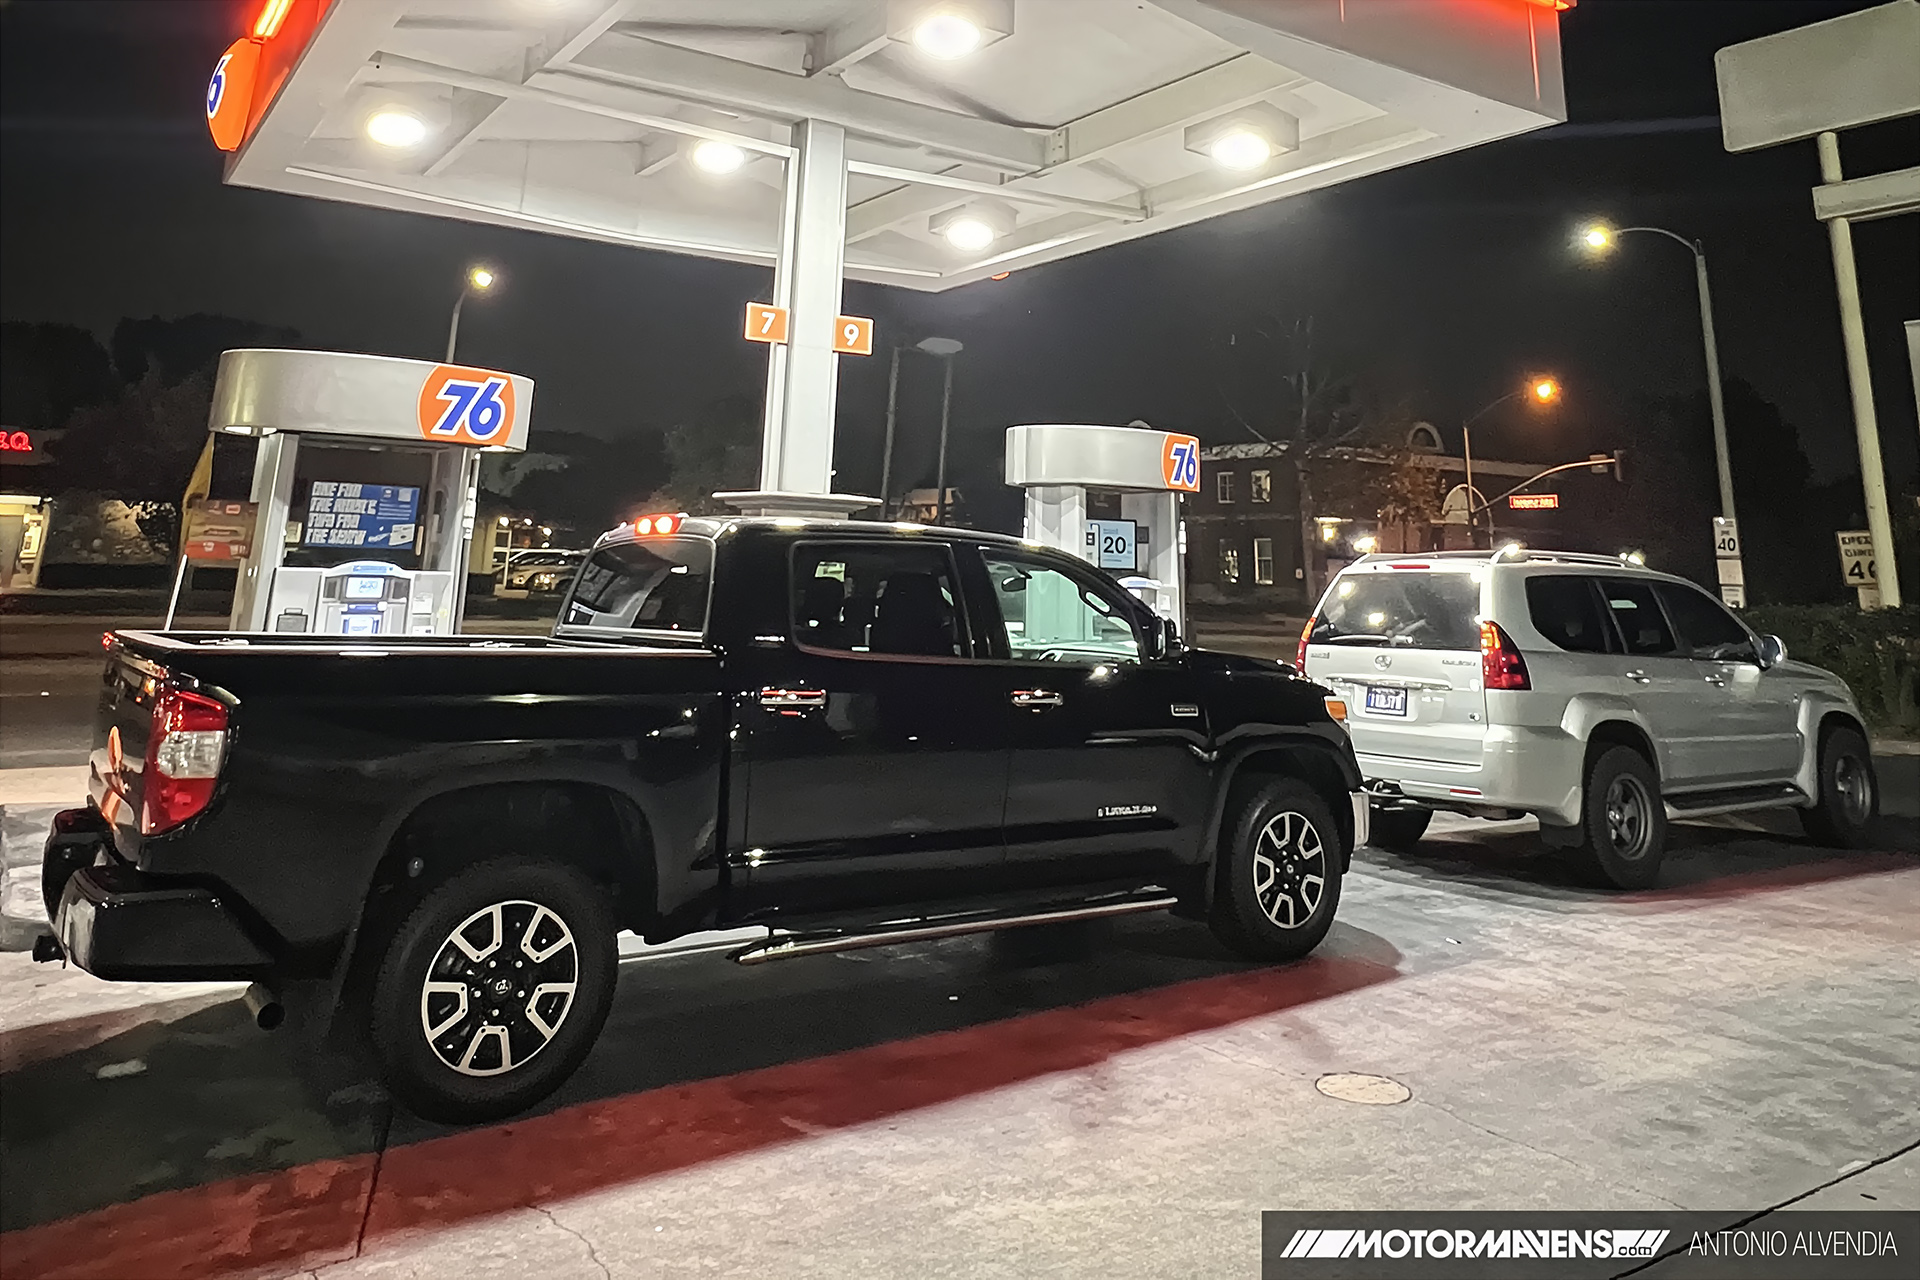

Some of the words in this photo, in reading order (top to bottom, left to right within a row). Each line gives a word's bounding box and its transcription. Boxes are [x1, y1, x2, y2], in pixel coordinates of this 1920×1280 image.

[761, 311, 776, 335] 7
[843, 323, 860, 347] 9
[430, 376, 508, 441] 76
[1169, 440, 1198, 488] 76
[1103, 536, 1127, 554] 20
[1717, 537, 1736, 552] 40
